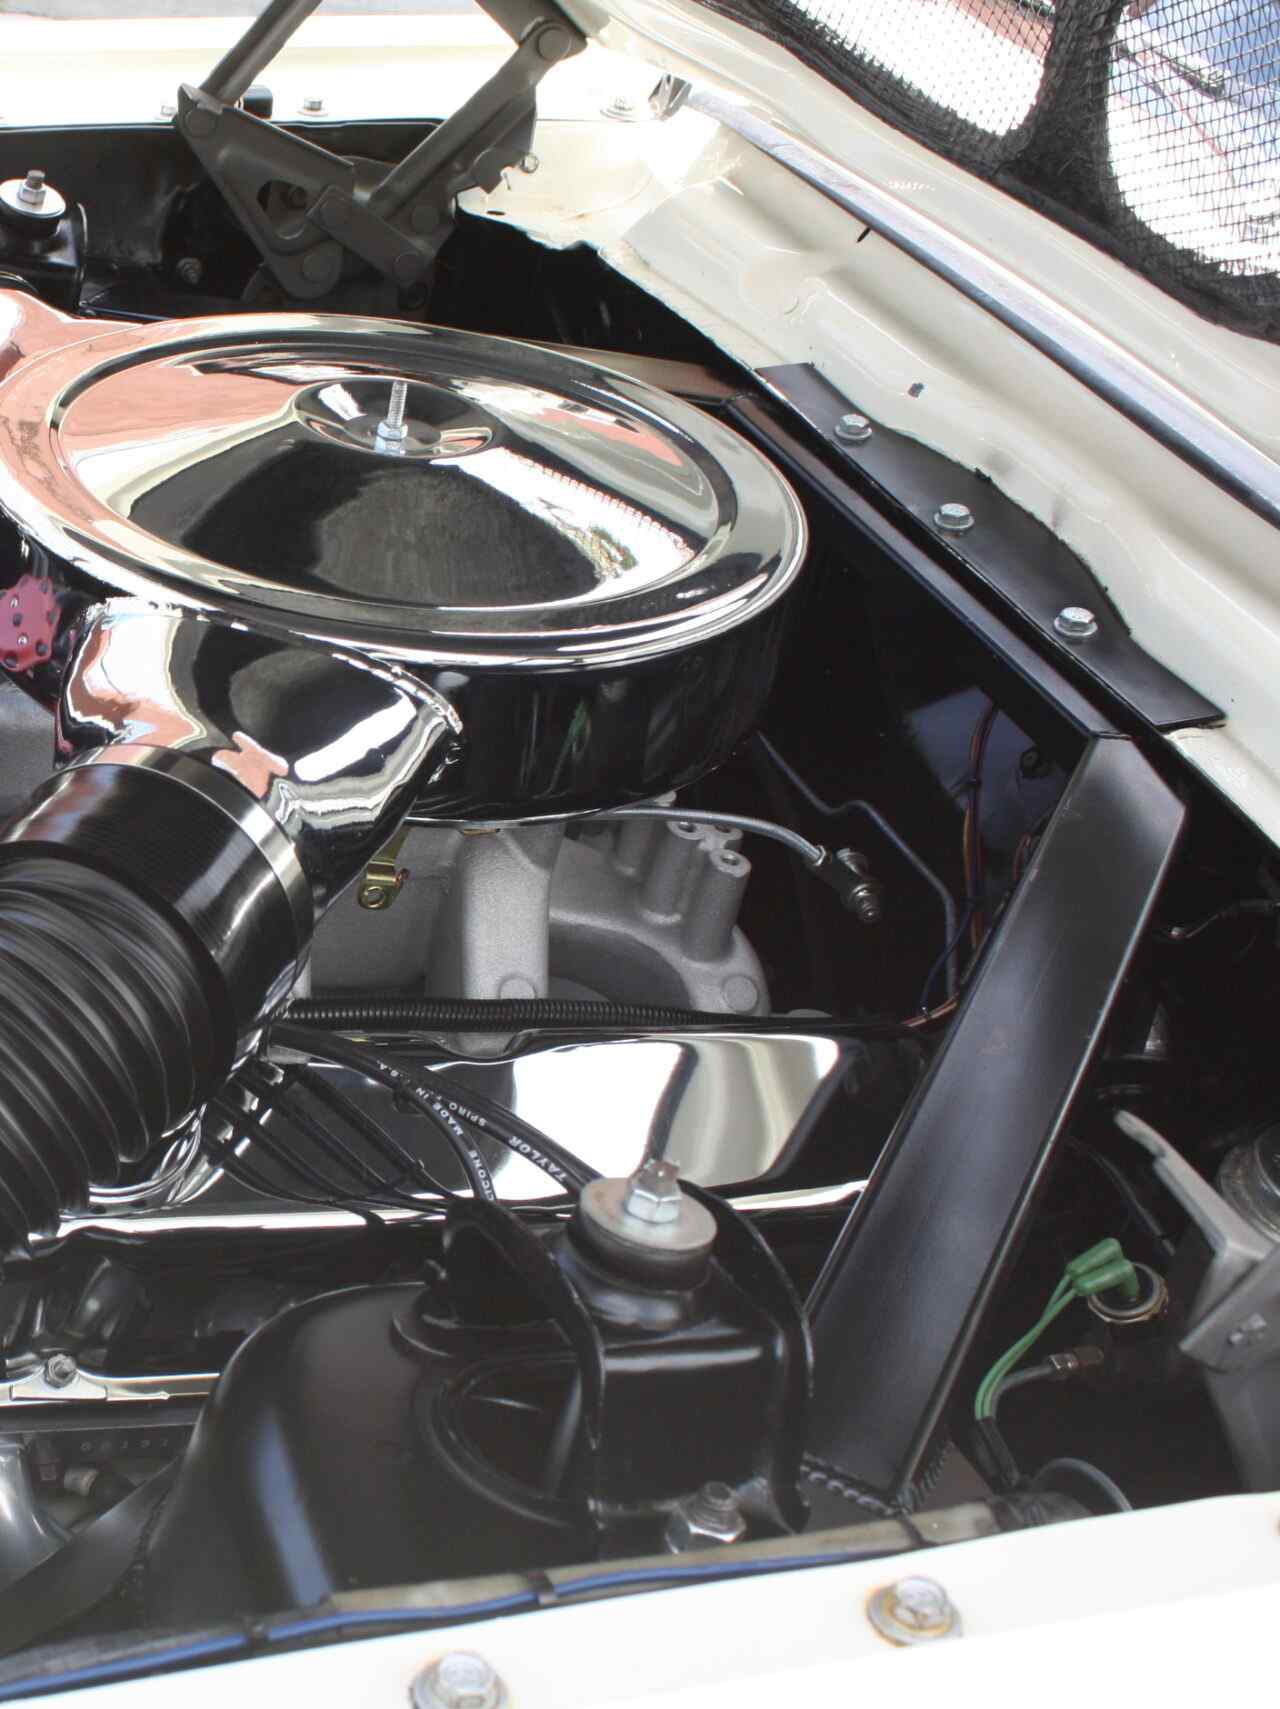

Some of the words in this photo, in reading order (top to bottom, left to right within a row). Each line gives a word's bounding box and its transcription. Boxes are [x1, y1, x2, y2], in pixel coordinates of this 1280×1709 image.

[416, 1087, 430, 1100] IN
[431, 1102, 464, 1136] MADE
[448, 1102, 488, 1127] SPIRO
[470, 1149, 495, 1201] LICONE
[509, 1135, 568, 1182] TAYLOR
